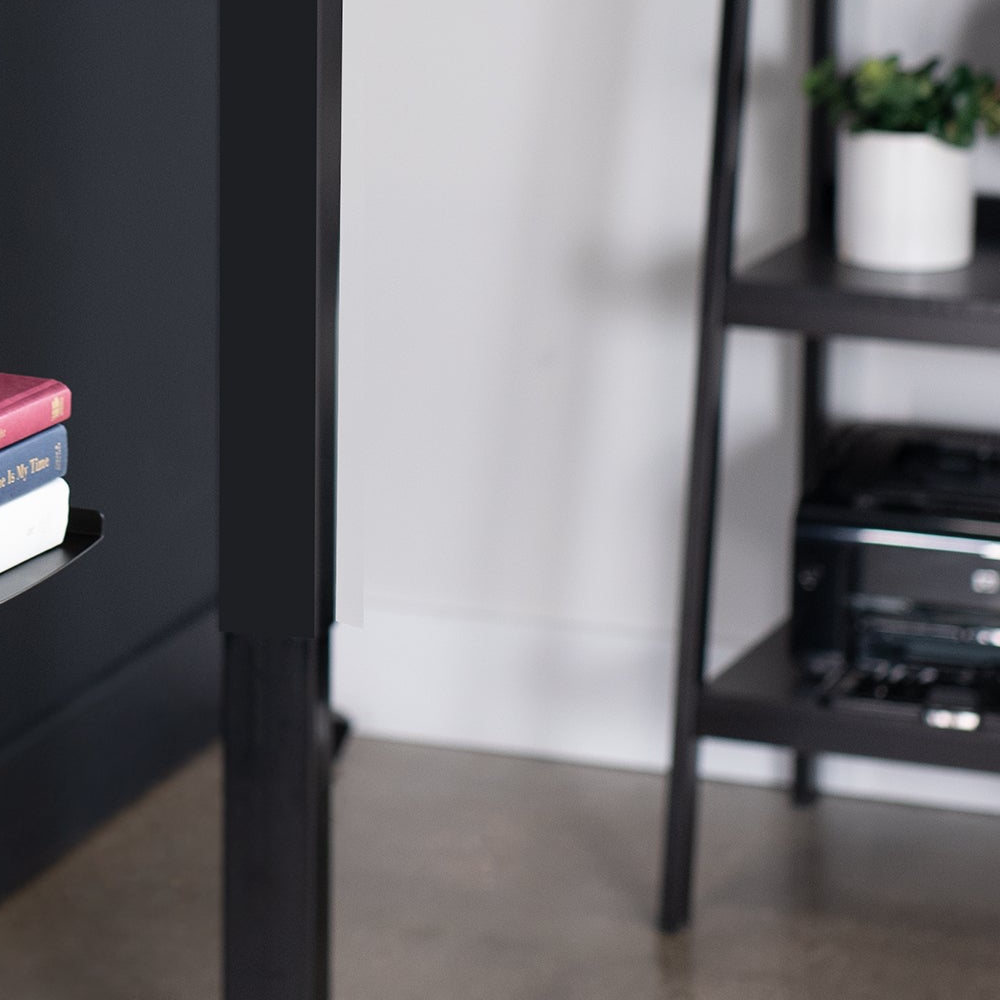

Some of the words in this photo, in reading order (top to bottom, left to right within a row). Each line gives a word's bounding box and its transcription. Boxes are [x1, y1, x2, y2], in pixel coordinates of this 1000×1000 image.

[7, 469, 15, 484] Is
[15, 463, 28, 481] My
[29, 457, 50, 474] Time
